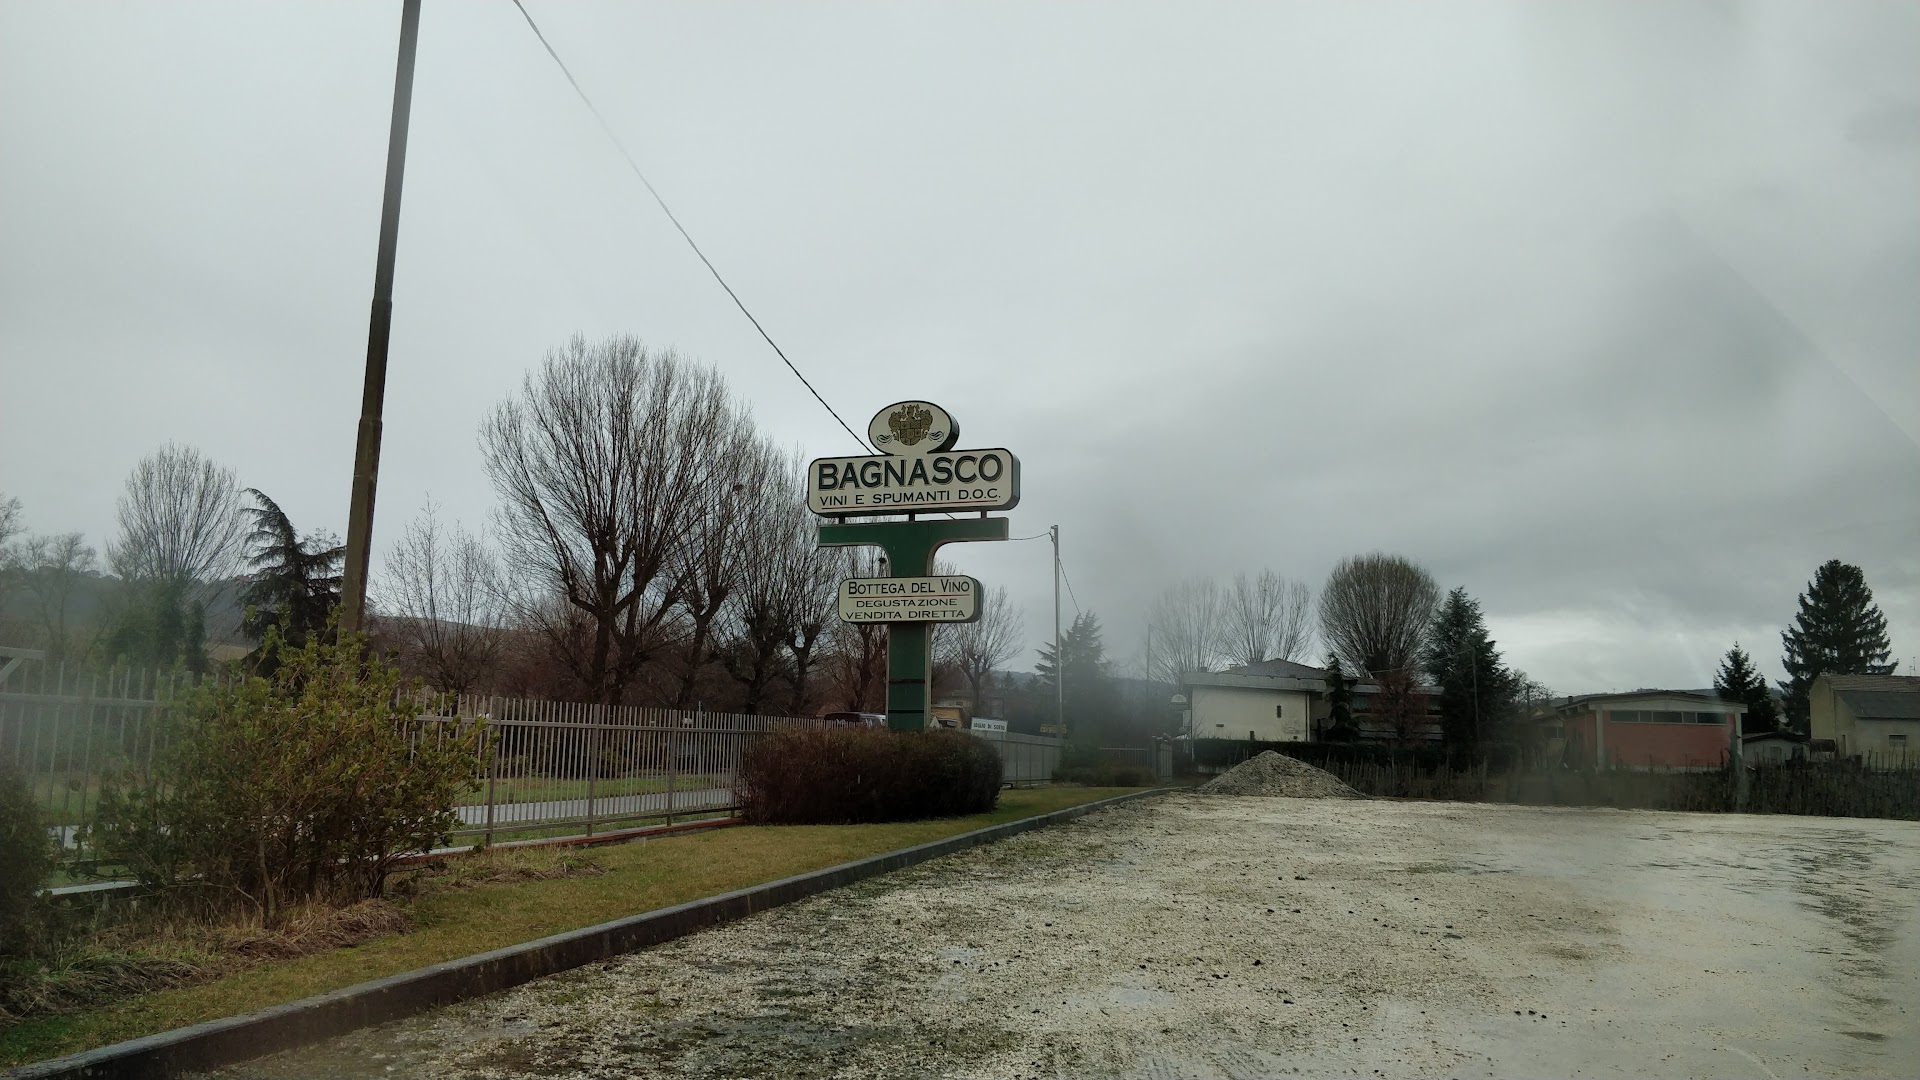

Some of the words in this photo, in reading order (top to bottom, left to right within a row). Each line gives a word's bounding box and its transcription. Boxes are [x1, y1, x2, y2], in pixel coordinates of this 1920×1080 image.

[818, 454, 1003, 491] BAGNASCO
[820, 494, 847, 506] VINI
[855, 494, 865, 505] E
[872, 490, 950, 504] SPUMANTI
[958, 488, 1001, 500] D.O.C.
[848, 581, 906, 595] BOTTEGA
[911, 582, 935, 593] DEL
[940, 579, 970, 593] VINO
[856, 598, 957, 608] DEGUSTAZIONE
[845, 611, 902, 620] VENDITA
[908, 610, 965, 619] DIRETTA
